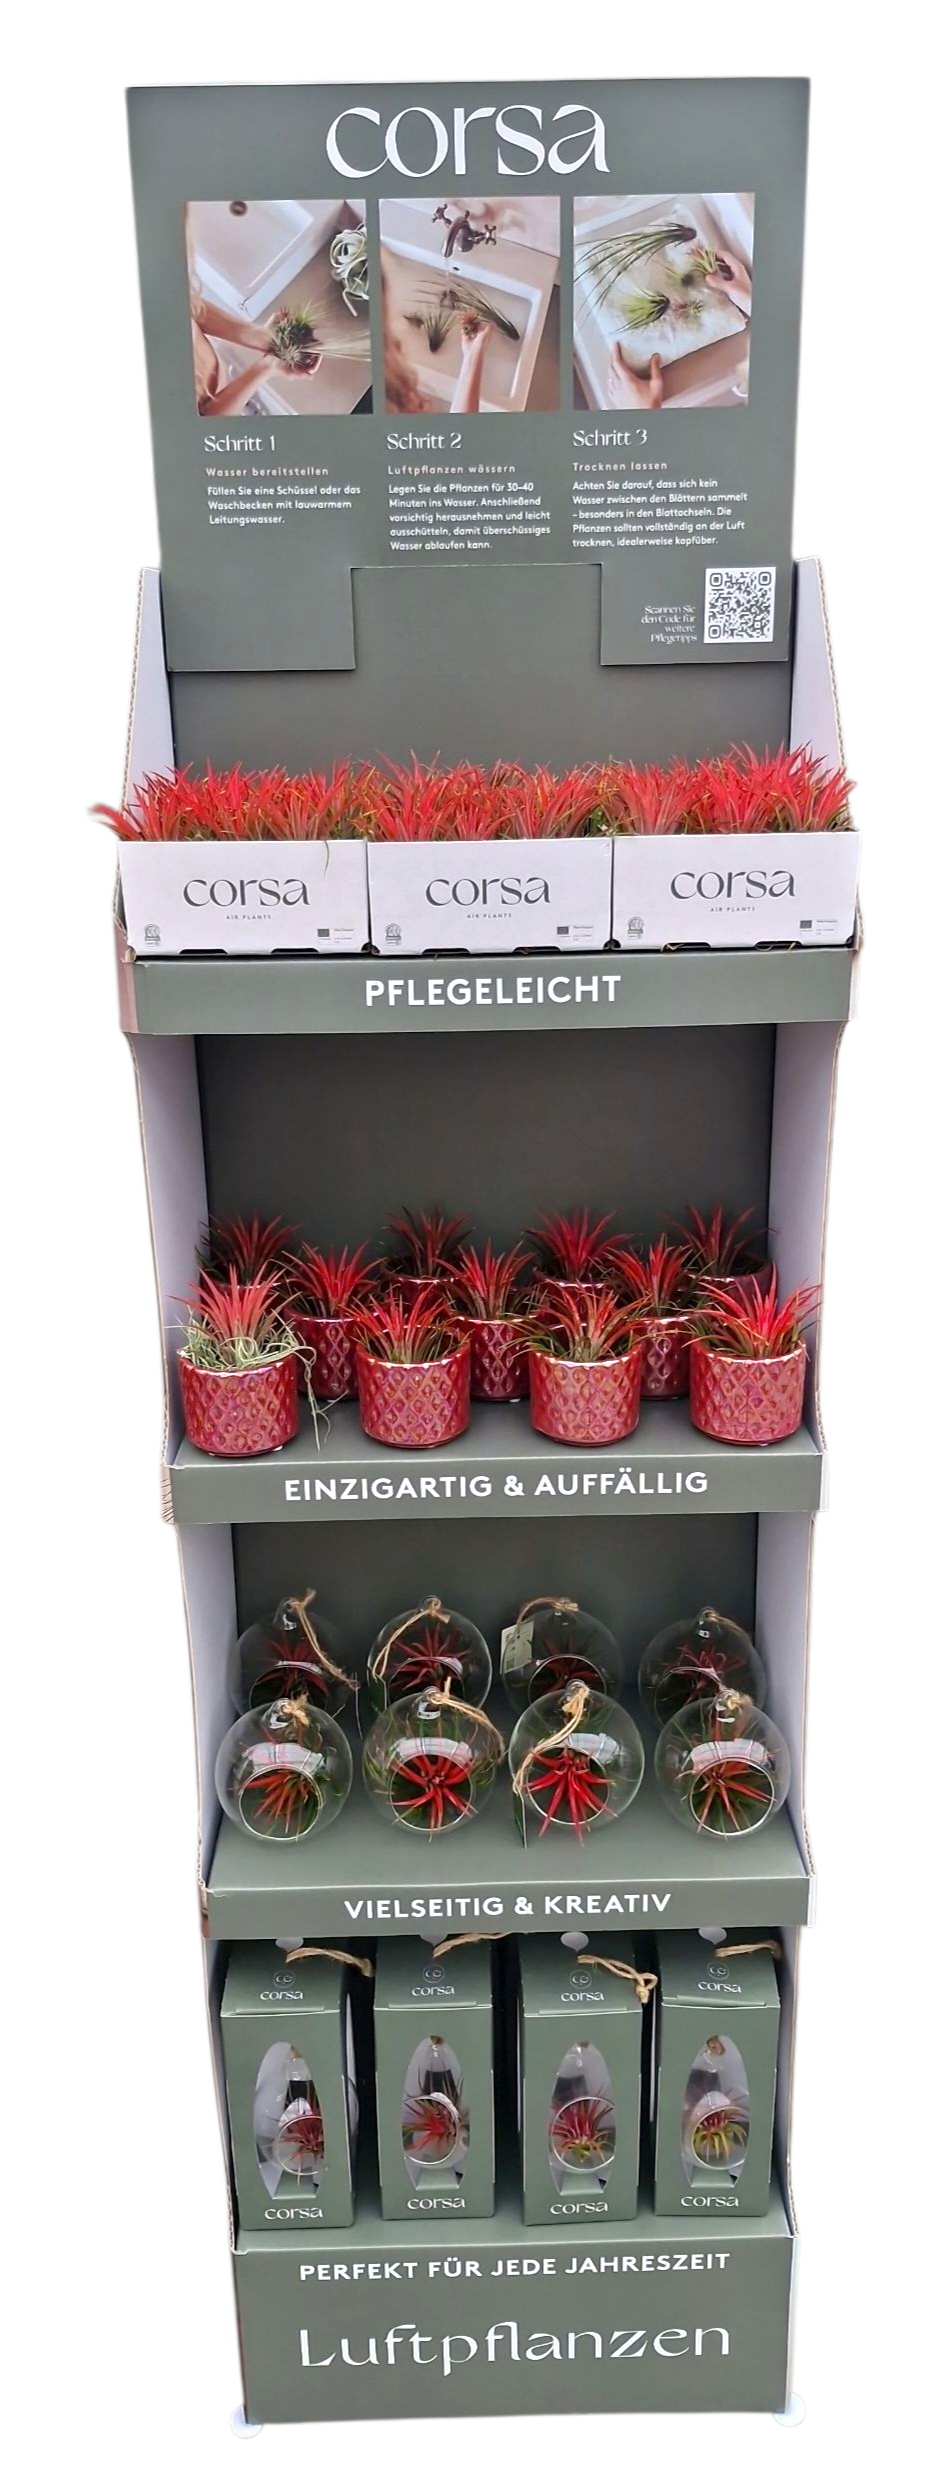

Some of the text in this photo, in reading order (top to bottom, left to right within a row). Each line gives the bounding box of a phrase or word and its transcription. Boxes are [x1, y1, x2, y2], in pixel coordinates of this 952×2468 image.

[325, 104, 611, 179] corsa
[204, 434, 275, 452] Schritt 1
[386, 432, 462, 450] Schritt 2
[573, 428, 648, 447] Schritt 3
[205, 466, 329, 477] Wasser bereitstellen
[387, 463, 516, 477] Luftpflanzen wässern
[572, 461, 668, 472] Trocknen lassen
[207, 484, 361, 496] Füllen Sie eine Schüssel oder das
[388, 484, 416, 496] Legen
[417, 483, 432, 494] Sie
[432, 483, 448, 493] die
[449, 483, 490, 493] Pflanzen
[490, 482, 506, 492] für
[572, 478, 718, 491] Achten Sie darauf, dass sich kein
[207, 499, 352, 511] Waschbecken mit lauwarmem
[388, 496, 542, 508] Minuten ins Wasser. Anschließend
[572, 492, 748, 505] Wasser zwischen den Blättern sammelt
[389, 510, 551, 524] vorsichtig herausnehmen und leicht
[578, 509, 625, 519] besonders
[625, 508, 635, 518] in
[636, 508, 654, 518] den
[655, 507, 715, 517] Blattachseln.
[716, 506, 732, 516] Die
[209, 514, 285, 527] Leitungswasser.
[572, 520, 746, 534] Pflanzen sollten vollständig an der Luft
[389, 525, 551, 537] ausschütteln, damit überschüssiges
[389, 540, 493, 551] Wasser ablaufen kann.
[572, 535, 719, 548] trocknen, idealerweise kopfüber.
[644, 604, 696, 616] Scannen Sie
[640, 613, 696, 624] den Code für
[664, 624, 696, 633] weitere
[650, 633, 698, 645] Pflegetipps
[425, 876, 551, 907] corsa
[670, 870, 795, 900] corsa
[183, 878, 310, 907] corsa
[365, 975, 622, 1007] PFLEGELEICHT
[284, 1467, 708, 1501] EINZIGARTIG & AUFFÄLLIG
[343, 1893, 672, 1919] VIELSEITIG & KREATIV
[411, 1985, 455, 1997] corsa
[697, 1981, 742, 1994] corsa
[259, 1991, 304, 2001] corsa
[560, 1991, 605, 2002] corsa
[407, 2197, 466, 2210] corsa
[550, 2201, 609, 2215] corsa
[680, 2196, 740, 2207] corsa
[264, 2207, 324, 2220] corsa
[299, 2253, 731, 2281] PERFEKT FÜR JEDE JAHRESZEIT
[299, 2321, 730, 2377] Luftpflanzen
